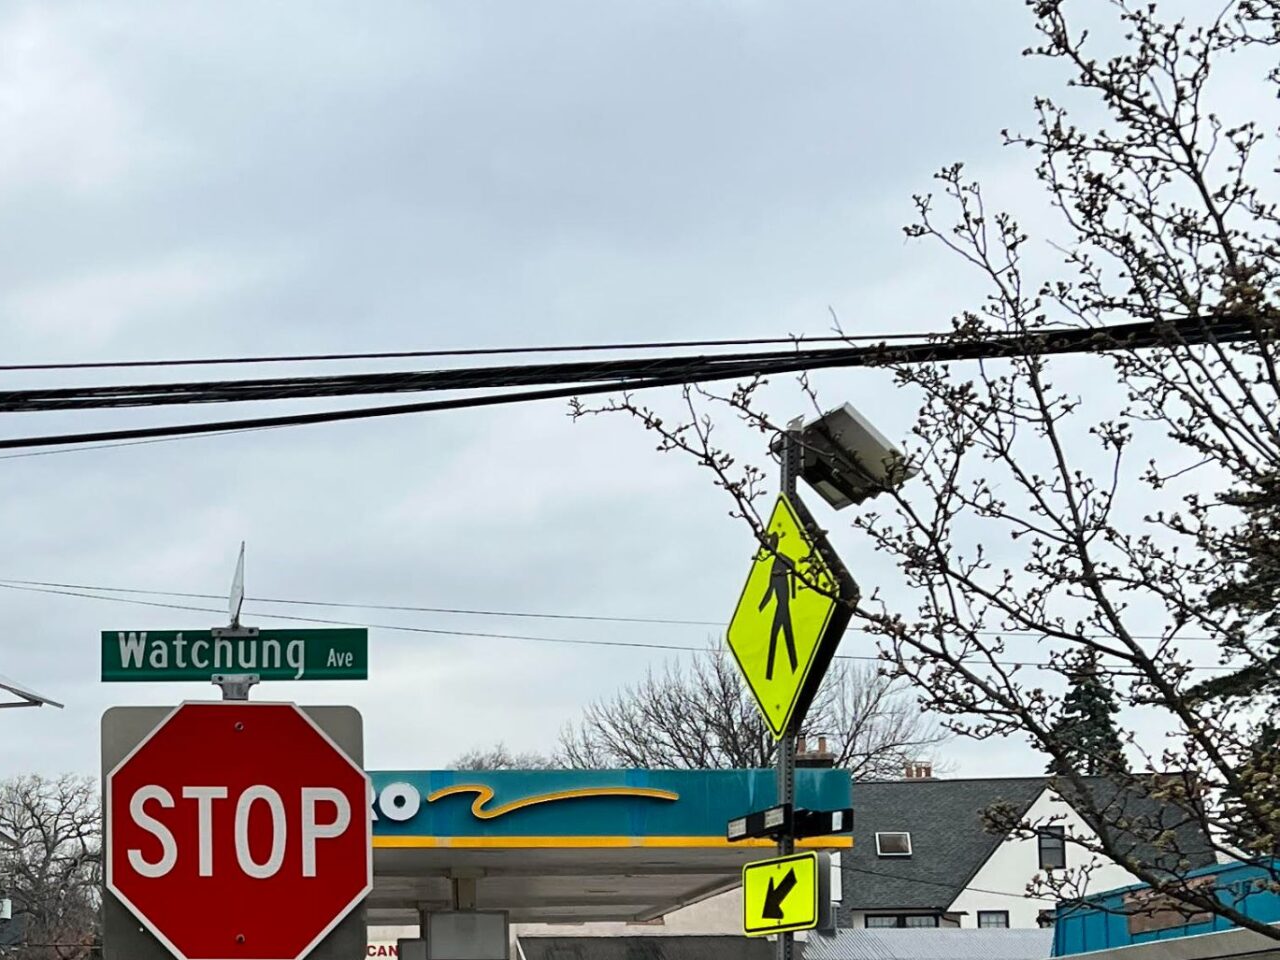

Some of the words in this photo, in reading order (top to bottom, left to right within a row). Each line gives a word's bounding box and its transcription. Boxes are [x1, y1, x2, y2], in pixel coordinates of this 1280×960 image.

[118, 632, 305, 680] Watchung
[326, 648, 354, 668] Ave
[127, 784, 352, 879] STOP
